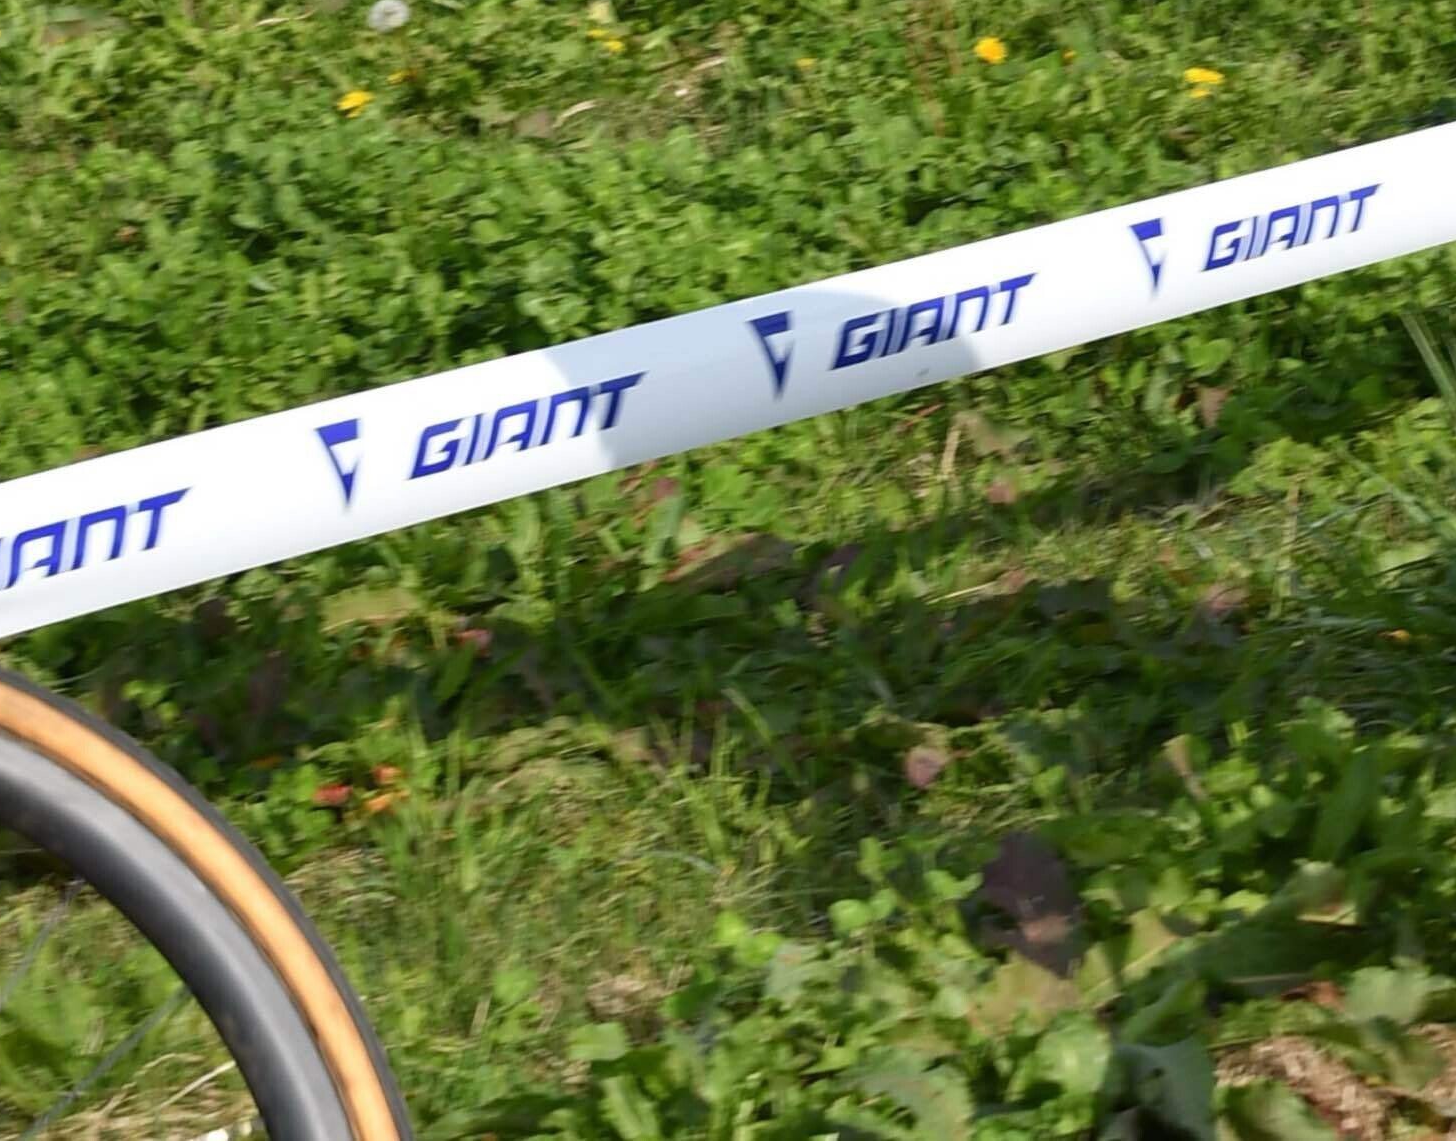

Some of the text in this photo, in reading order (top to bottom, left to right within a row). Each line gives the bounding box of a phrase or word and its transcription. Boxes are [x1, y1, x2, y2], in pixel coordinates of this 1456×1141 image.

[1203, 183, 1380, 271] GIANT
[832, 273, 1035, 369] GIANT
[410, 372, 644, 479] GIANT
